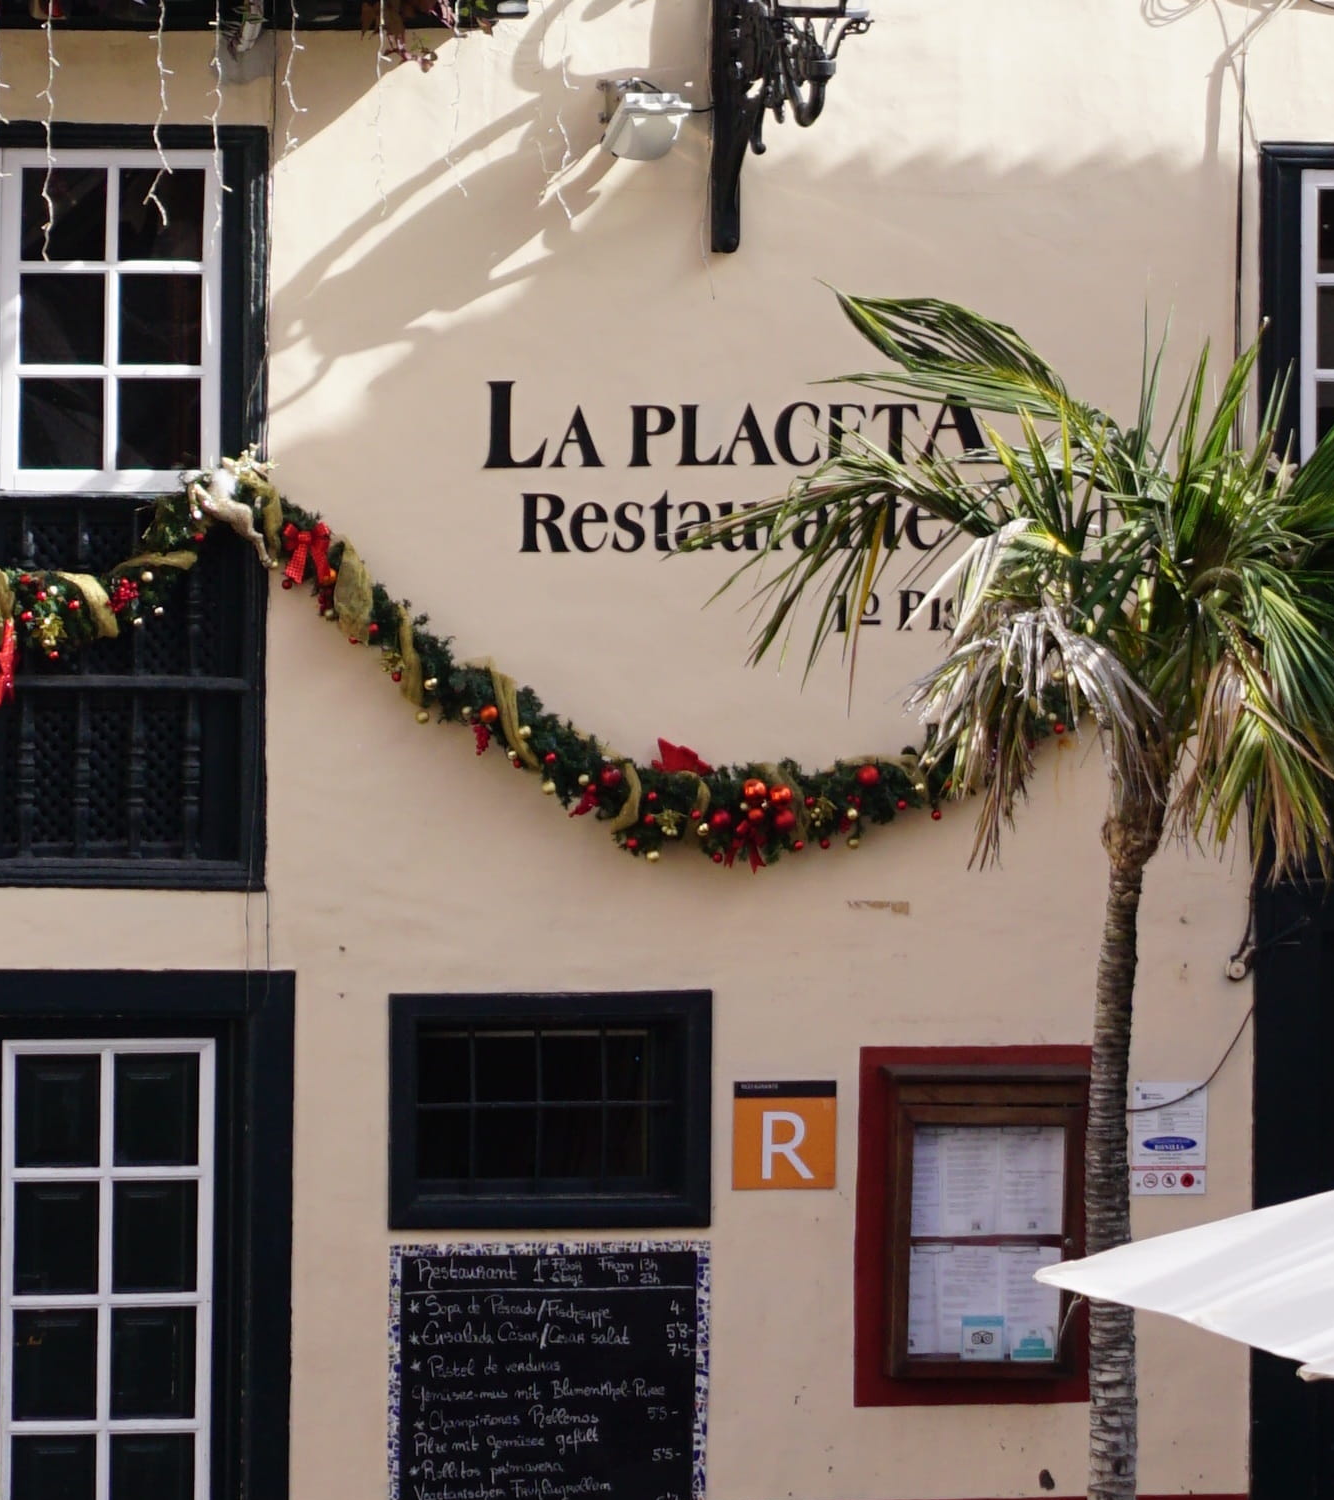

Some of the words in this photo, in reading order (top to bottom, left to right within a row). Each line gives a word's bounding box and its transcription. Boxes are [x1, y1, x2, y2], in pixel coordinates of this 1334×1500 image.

[761, 1110, 815, 1180] R
[413, 1256, 517, 1290] Restaurant
[424, 1294, 464, 1323] Sopa
[467, 1295, 481, 1316] de
